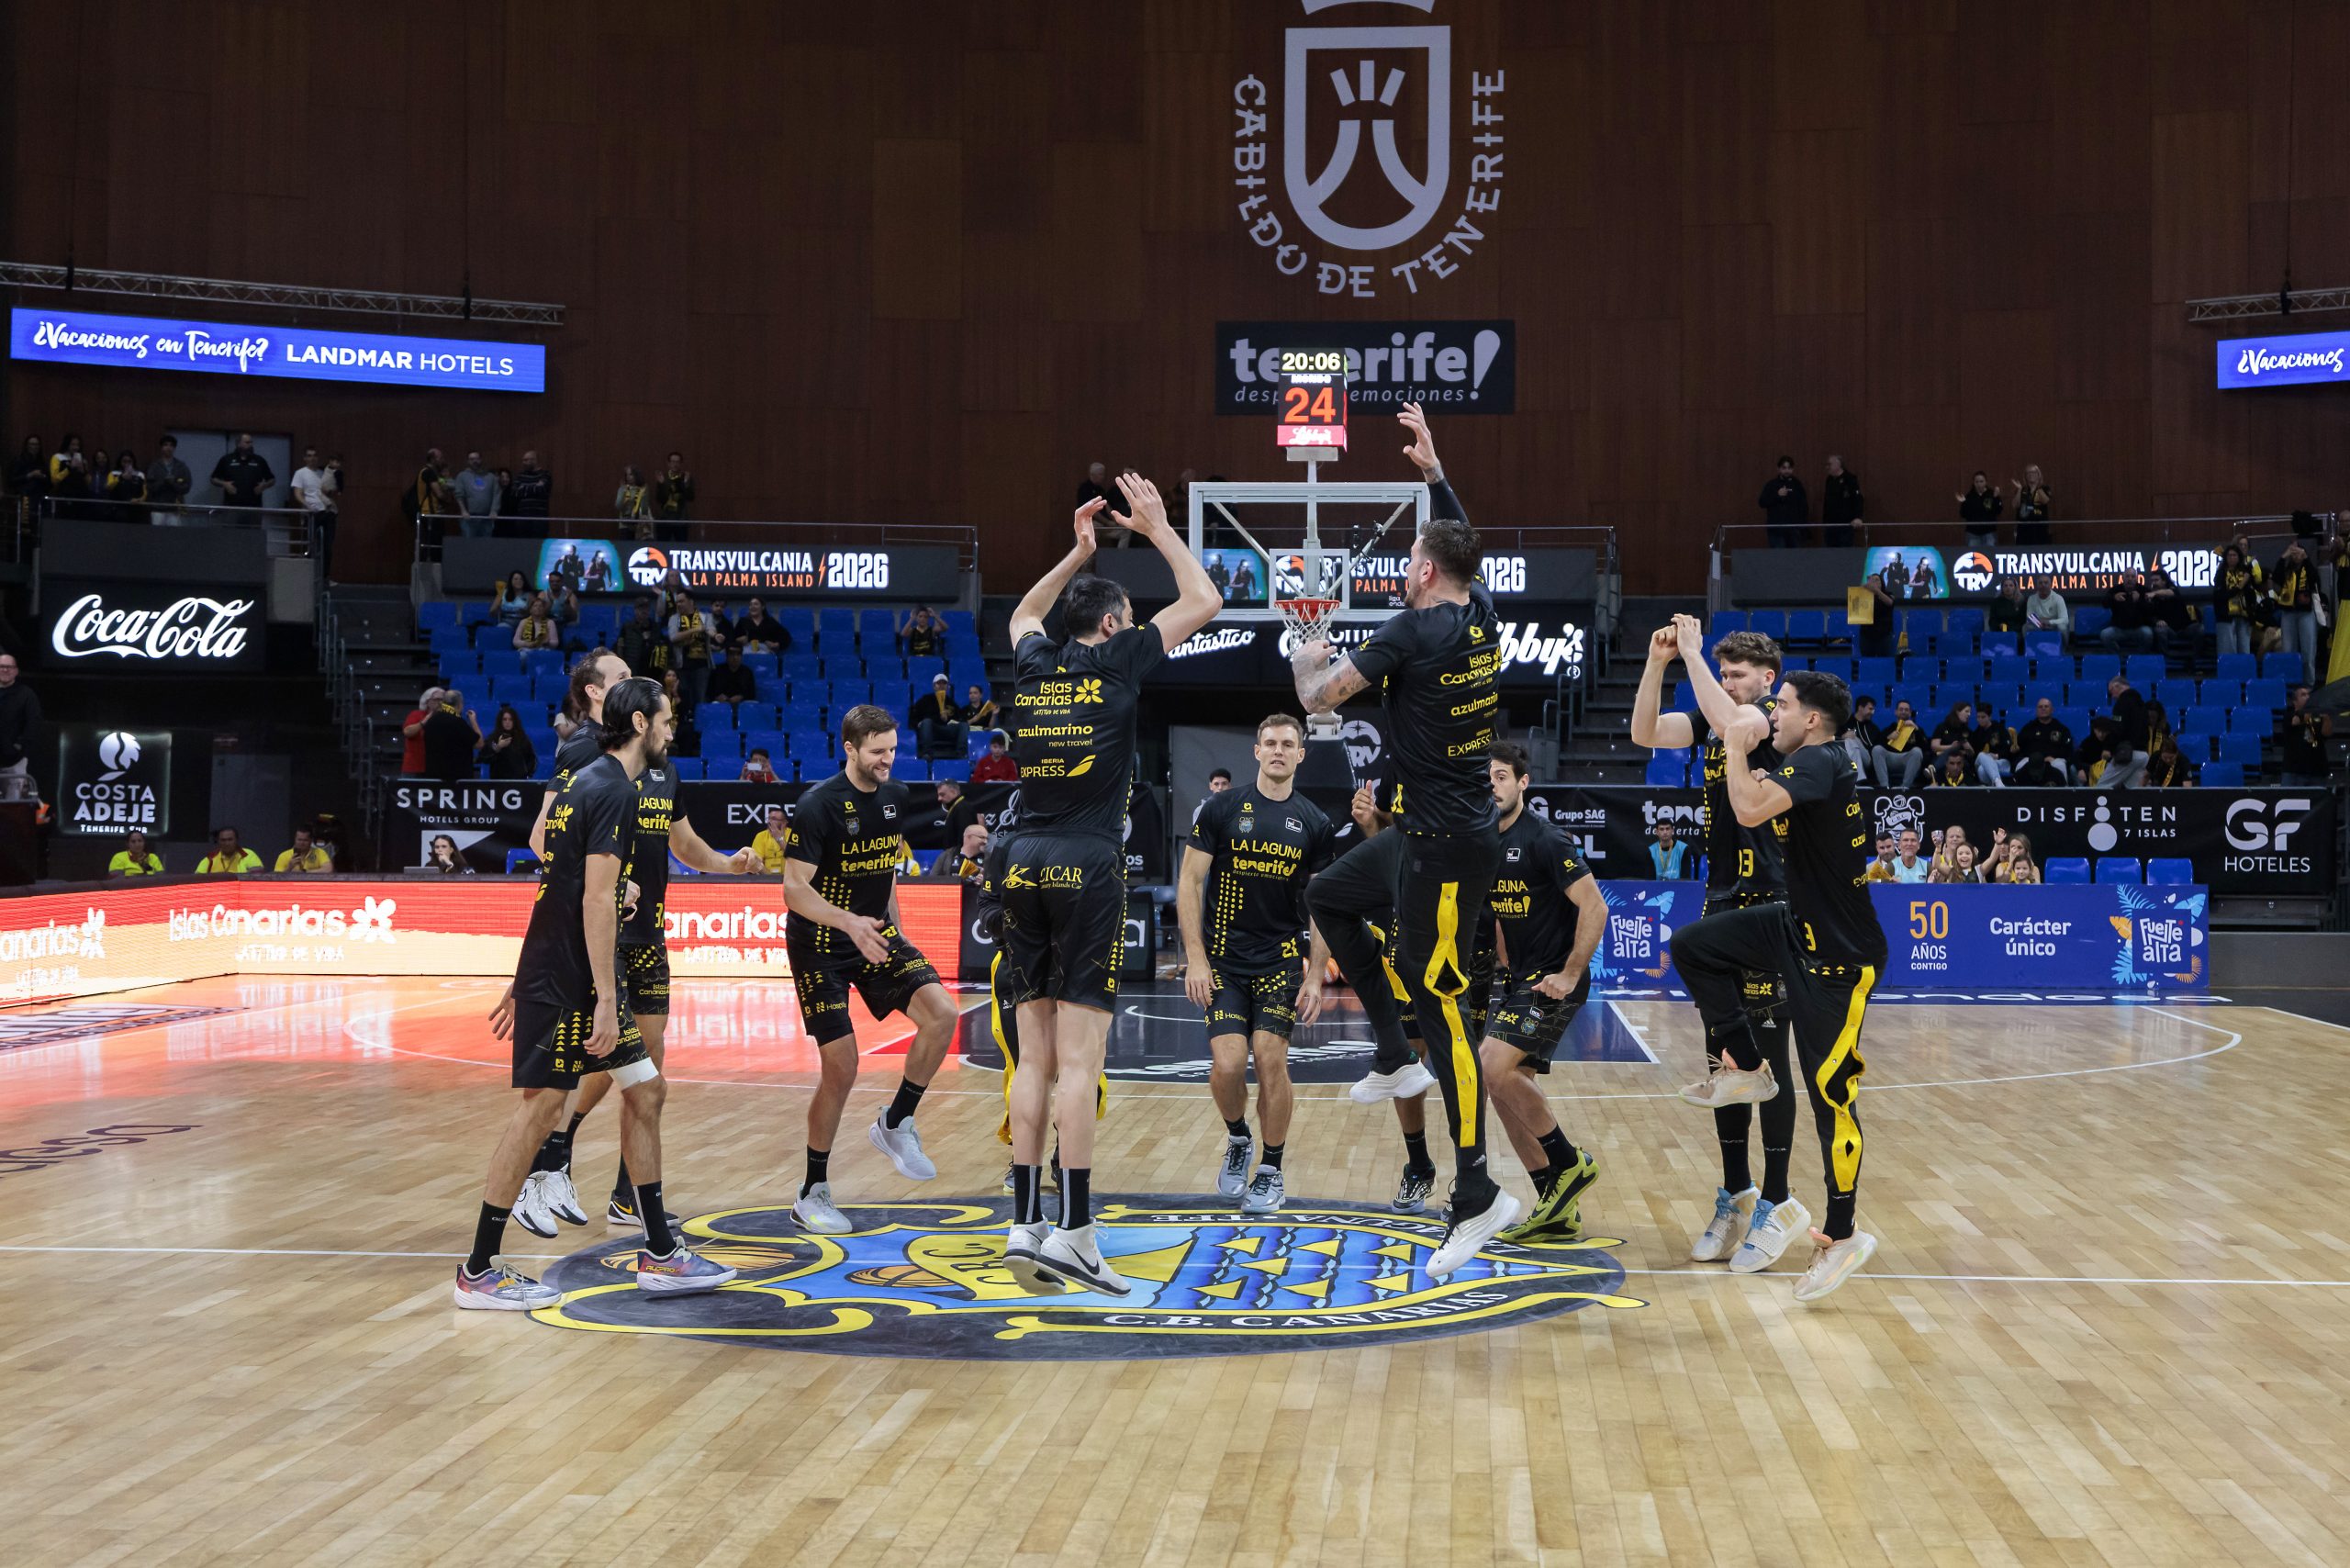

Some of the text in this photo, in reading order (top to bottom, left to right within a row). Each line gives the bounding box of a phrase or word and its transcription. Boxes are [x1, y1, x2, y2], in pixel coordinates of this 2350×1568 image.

[1234, 70, 1505, 297] CABILDO DE TENERIFE
[33, 321, 514, 376] ¿Vacaciones en Tenerife? LANDMAR HOTELS
[1229, 329, 1501, 400] teerife!
[1281, 353, 1340, 371] 20:06
[2237, 348, 2344, 375] ¿Vacaciones
[1349, 386, 1464, 402] emociones
[1284, 386, 1337, 423] 24
[669, 549, 890, 588] TRANSVULCANIA 2026
[1995, 551, 2145, 574] TRANSVULCANIA
[692, 571, 813, 588] LA PALMA ISLAND
[1482, 556, 1526, 592] 026
[2020, 575, 2035, 589] LA
[2052, 575, 2087, 589] ALMA
[1355, 578, 1397, 593] PALMA
[51, 593, 254, 659] Coca-Cola
[1168, 628, 1256, 659] antástico
[1470, 653, 1493, 669] Islas
[1439, 664, 1494, 685] Canarias
[1040, 681, 1072, 694] Islas
[1014, 693, 1072, 707] Canarias
[1450, 692, 1498, 716] azulmarin
[1018, 723, 1093, 737] azulmarino
[1048, 738, 1093, 748] new travel
[1348, 745, 1382, 767] RV
[1020, 765, 1066, 778] EXPRESS
[75, 782, 156, 802] COSTA
[397, 788, 522, 811] SPRING
[73, 800, 156, 823] ADEJE
[420, 815, 499, 824] HOTELS GROUP
[1554, 809, 1606, 822] Grupo SAG
[80, 823, 125, 834] TENERIFE
[2124, 828, 2177, 837] 7 ISLAS
[2225, 798, 2311, 851] GF
[841, 842, 859, 855] LA
[1231, 838, 1303, 860] LA LAGUNA
[2225, 855, 2311, 873] HOTELES
[1489, 879, 1529, 893] GUNA
[169, 903, 347, 942] Islas Canarias
[664, 905, 788, 939] anarias
[1909, 901, 1949, 939] 50
[1989, 916, 2072, 936] Carácter
[0, 919, 81, 962] anarias
[1281, 937, 1299, 958] 21
[2005, 937, 2056, 957] único
[1910, 942, 1947, 960] AÑOS
[1910, 962, 1948, 970] CONTIGO
[616, 1032, 641, 1045] anarias
[1292, 1215, 1447, 1238] AGUNA
[1103, 1291, 1509, 1327] C.B. CANARIAS
